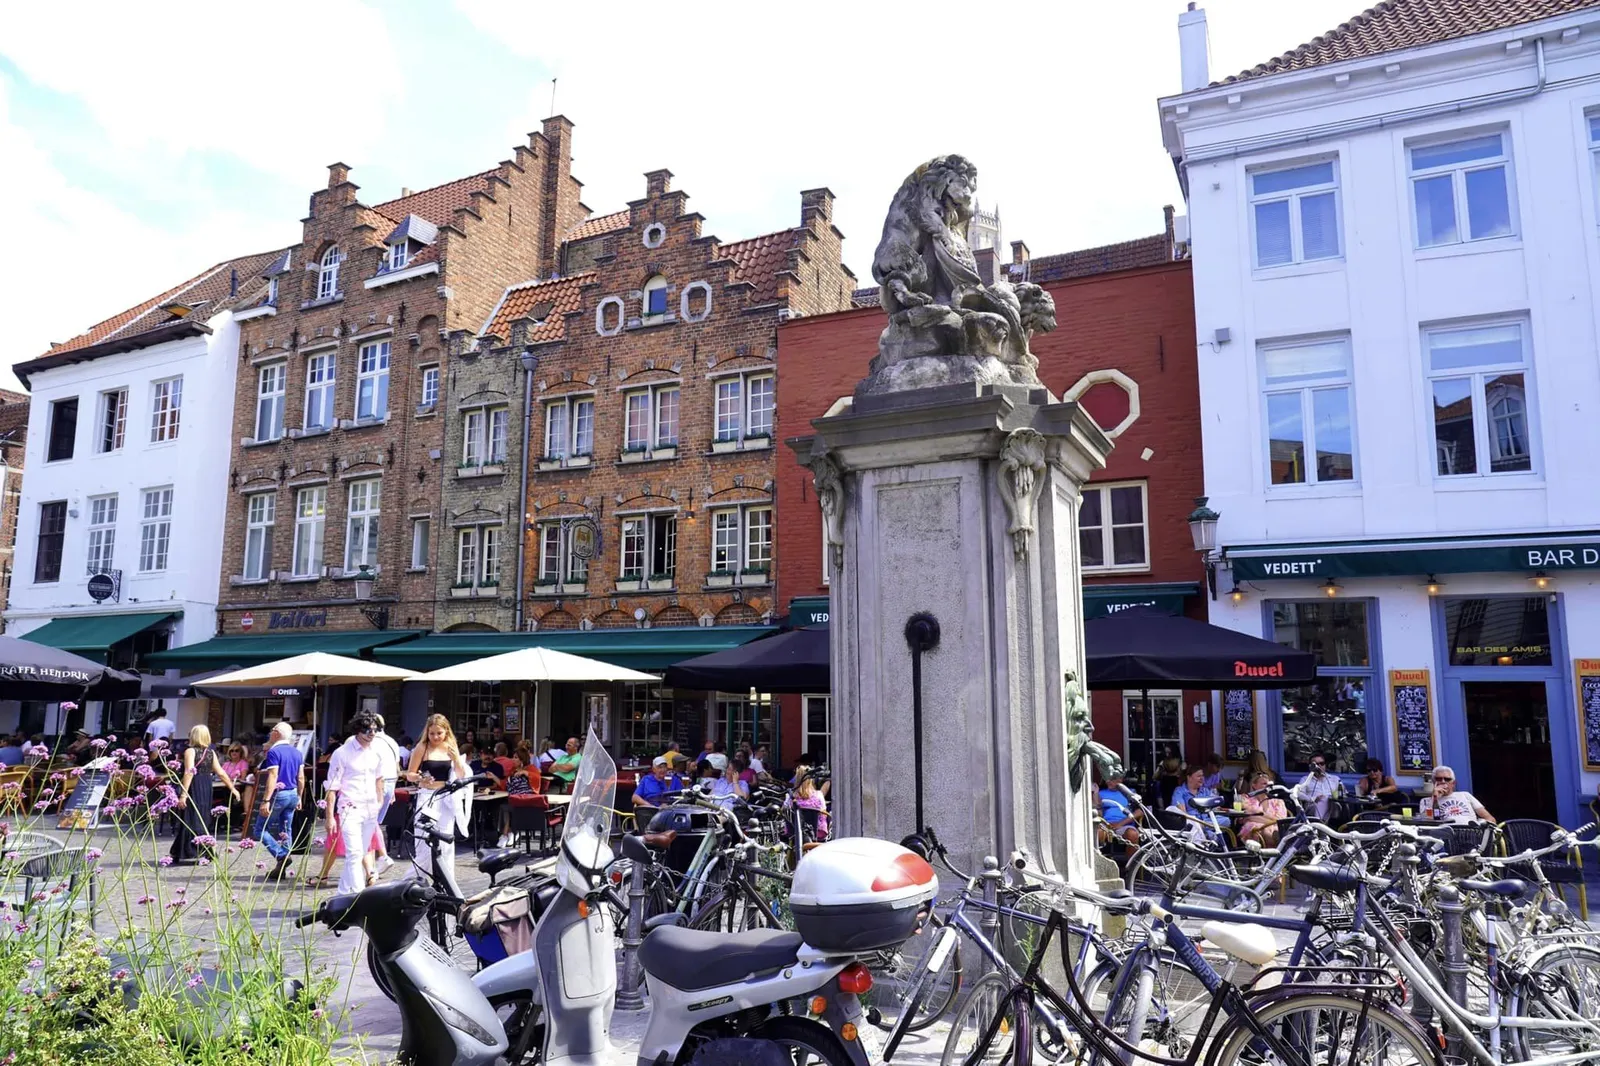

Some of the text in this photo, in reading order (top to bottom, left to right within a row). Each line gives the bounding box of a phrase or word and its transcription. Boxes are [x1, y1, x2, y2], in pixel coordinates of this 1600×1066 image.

[1528, 549, 1576, 566] BAR
[1263, 561, 1317, 575] VEDETT
[1106, 603, 1152, 614] VED
[268, 607, 328, 629] Belfort
[1456, 646, 1481, 654] BAR
[1511, 645, 1542, 653] AMIS
[0, 665, 90, 682] RAFFE HENDRIK
[1234, 660, 1284, 677] Duvel
[1394, 670, 1425, 680] Duvel
[1181, 942, 1221, 990] THOMPSO
